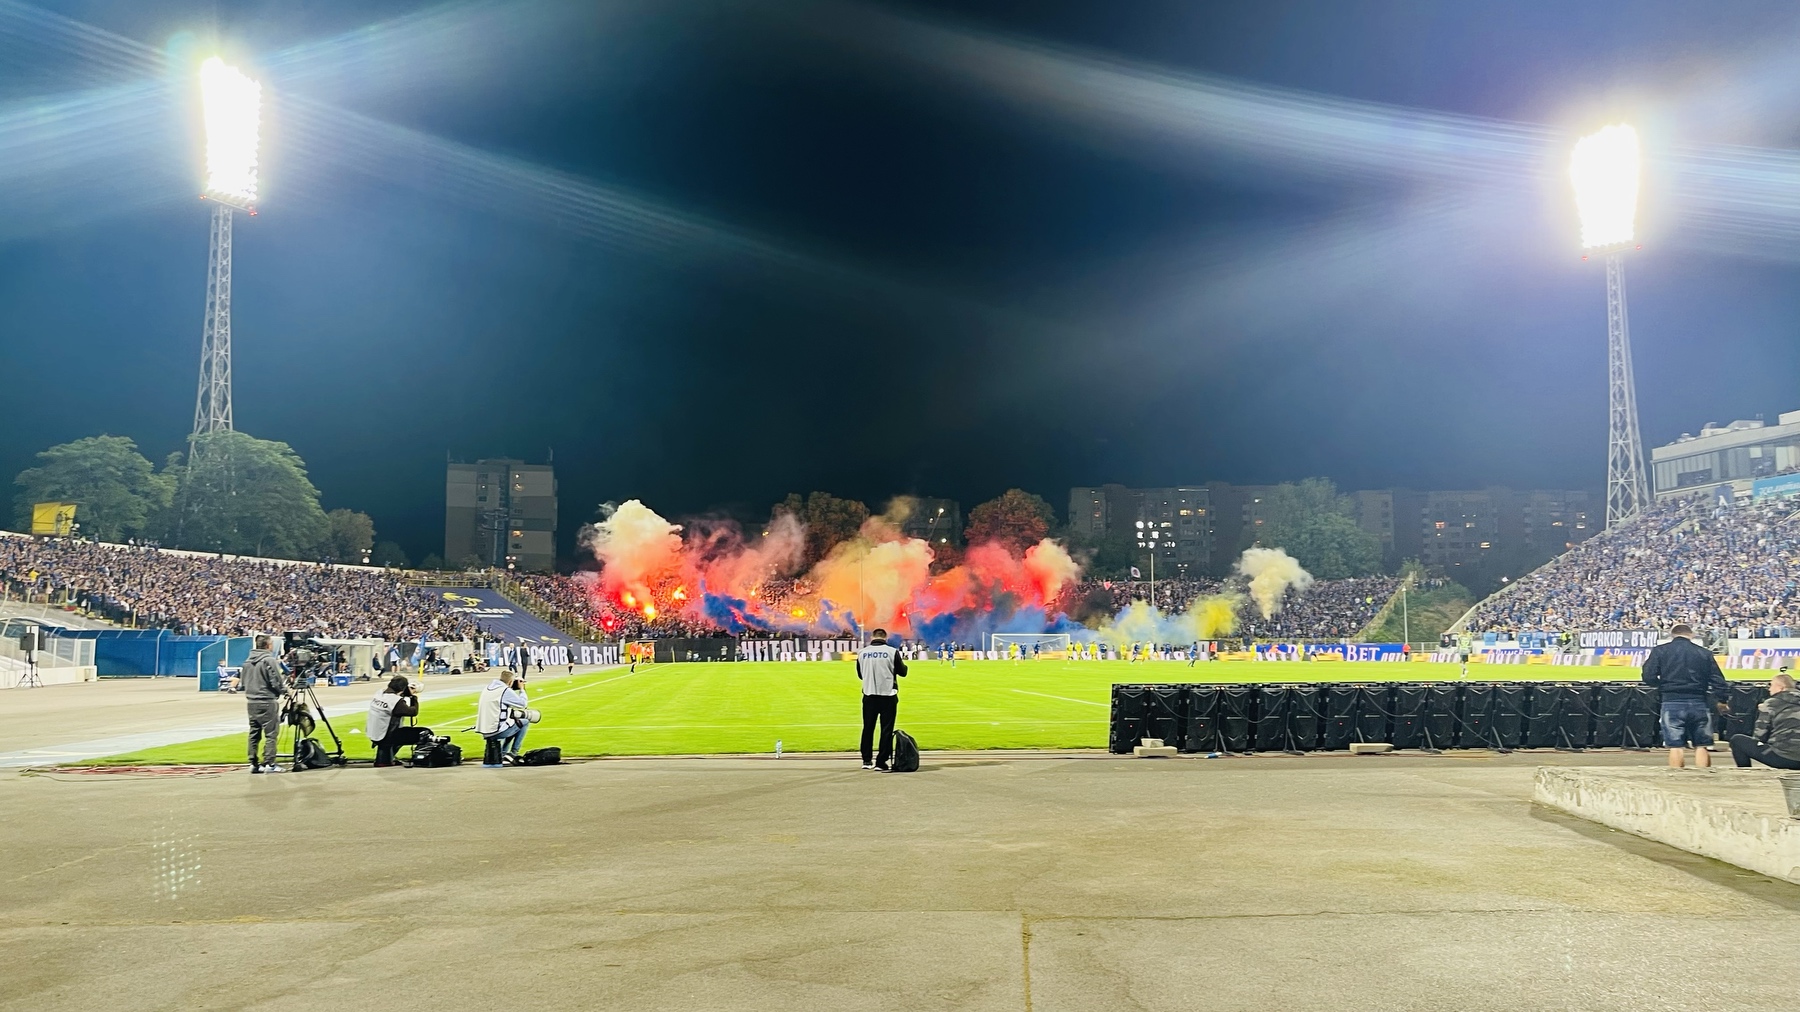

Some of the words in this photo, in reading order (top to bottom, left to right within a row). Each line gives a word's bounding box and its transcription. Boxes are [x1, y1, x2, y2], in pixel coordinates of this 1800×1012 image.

[1580, 631, 1623, 647] СИРАКОВ
[581, 646, 617, 665] ВЪН!
[863, 652, 889, 660] PHOTO
